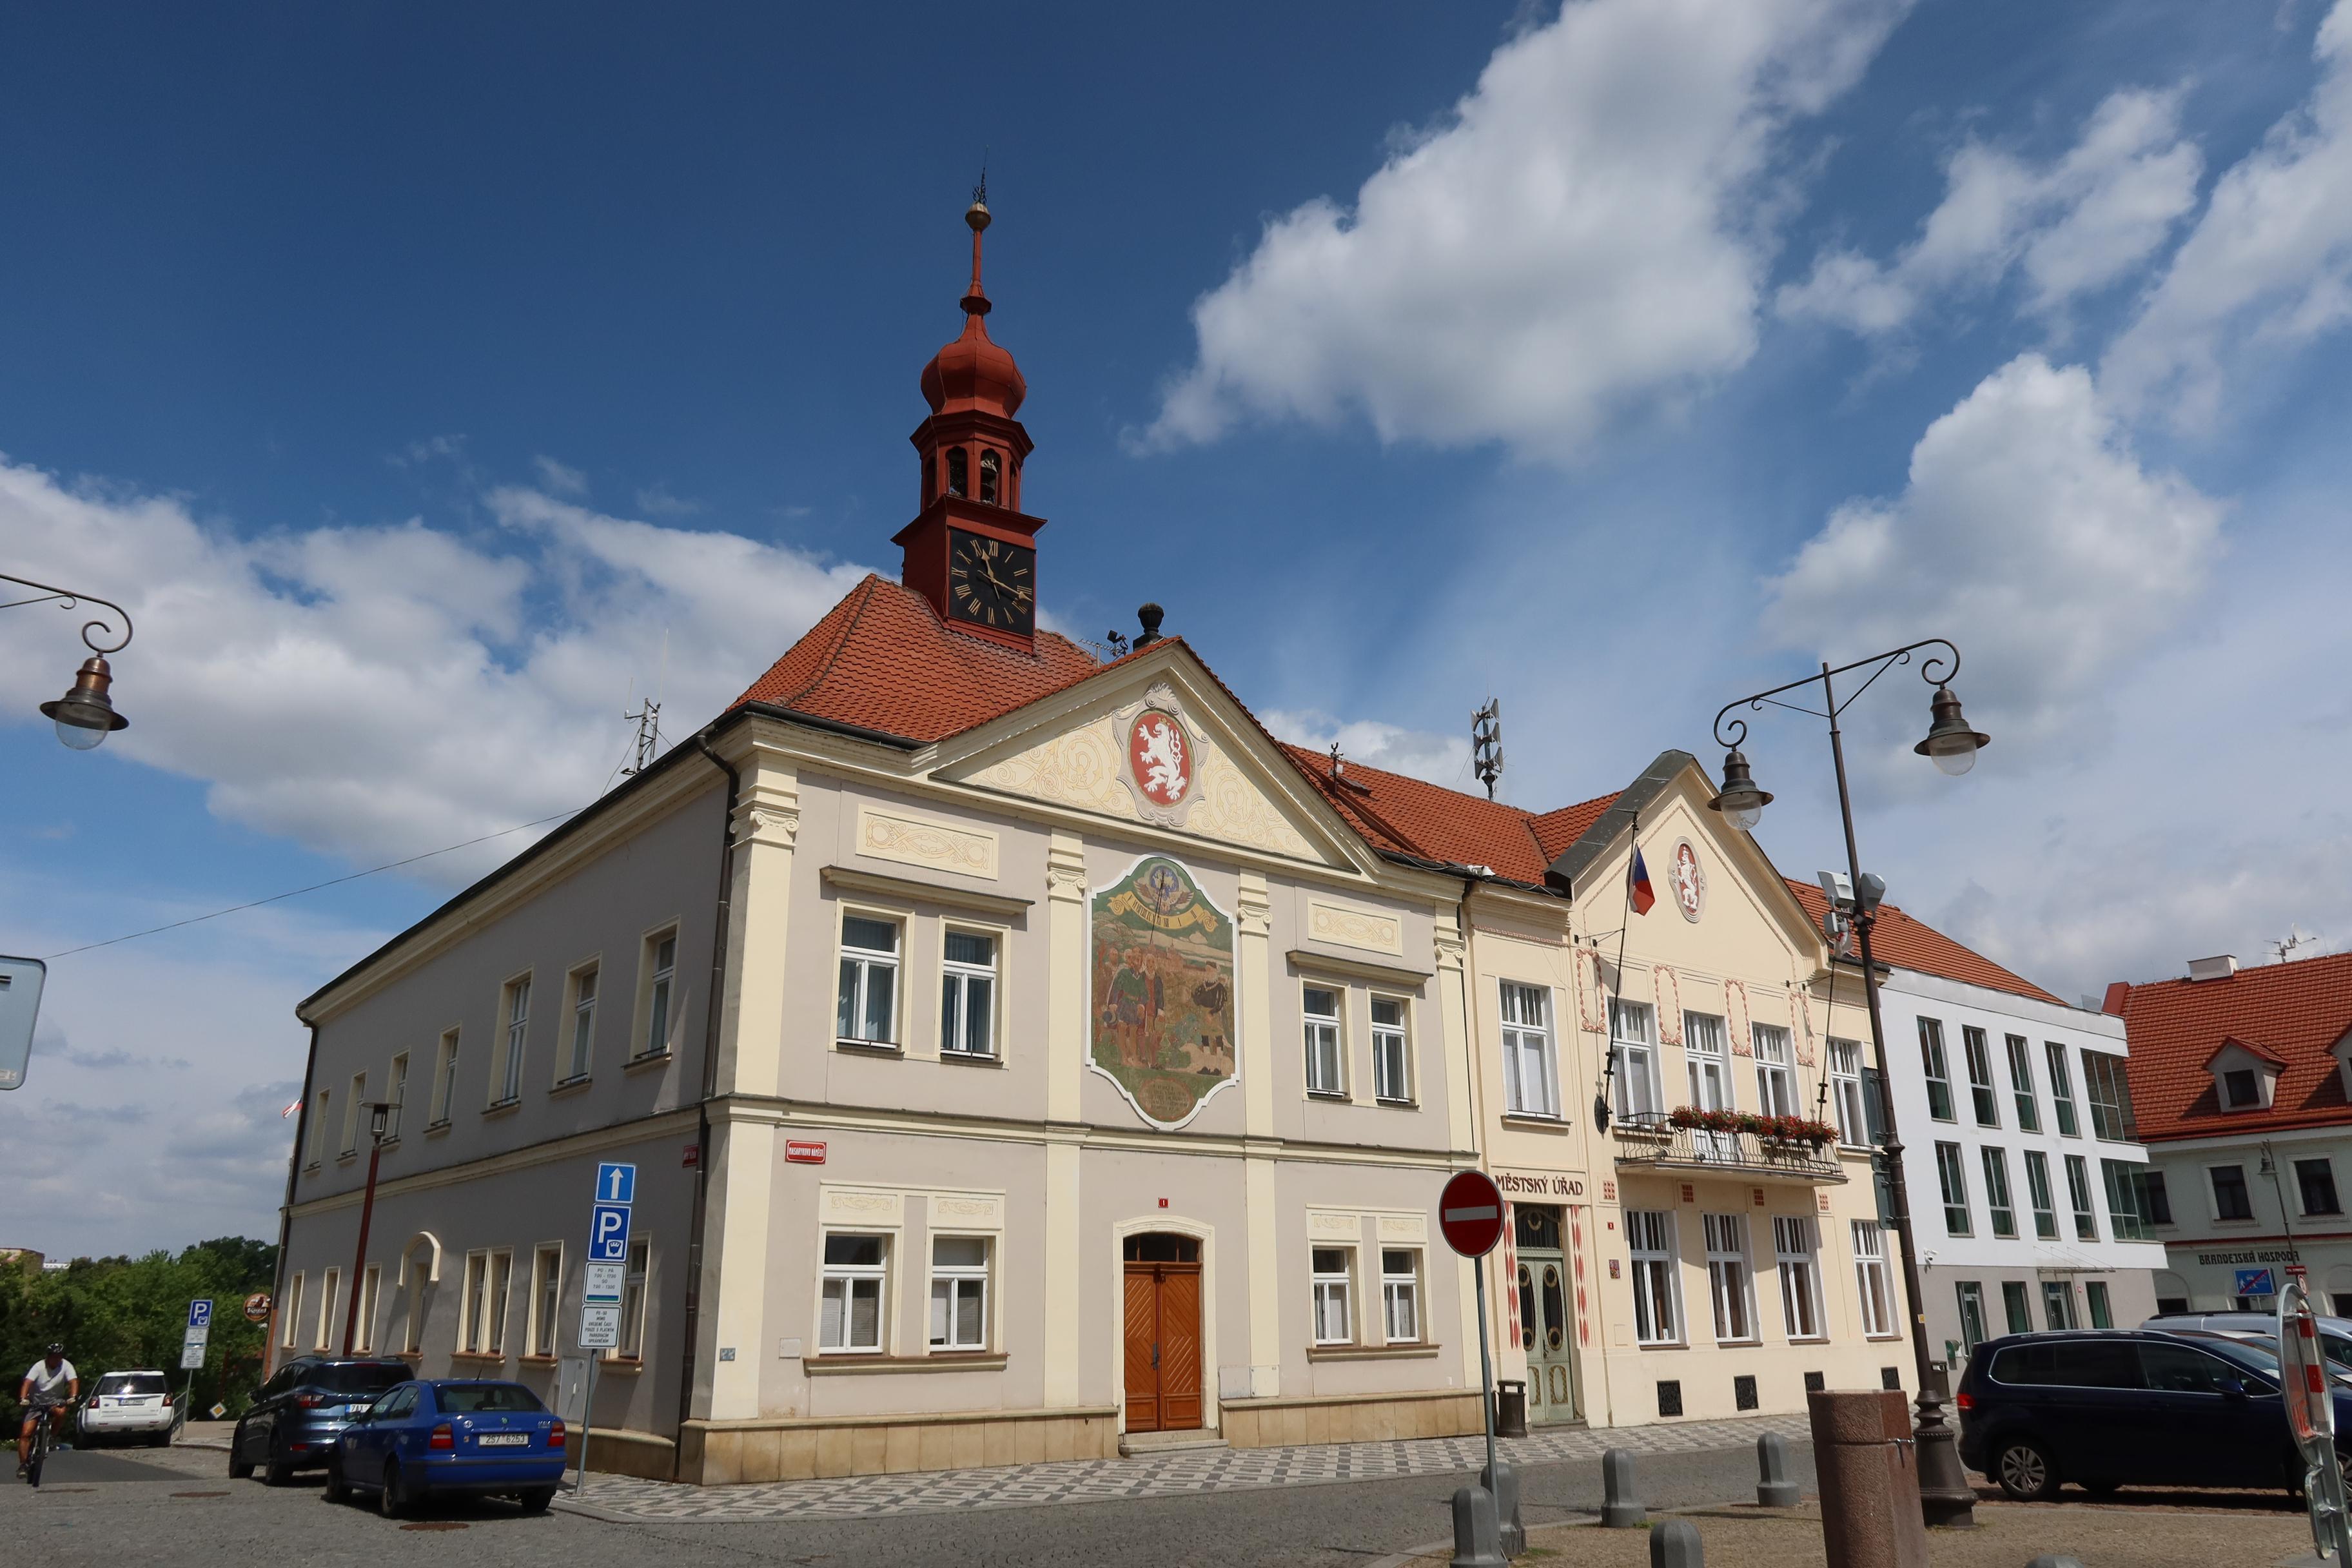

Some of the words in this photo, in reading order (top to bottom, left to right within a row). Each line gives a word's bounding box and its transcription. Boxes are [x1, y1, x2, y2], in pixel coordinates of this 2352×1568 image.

[989, 540, 998, 557] XII
[952, 567, 967, 578] IX
[955, 584, 972, 599] VIII
[968, 598, 981, 616] VII
[988, 607, 995, 624] VI
[789, 1147, 811, 1156] MASARYKOVO
[1494, 1172, 1549, 1195] MĚSTSKÝ
[1552, 1175, 1584, 1196] ÚŘAD
[598, 1211, 622, 1244] P
[2198, 1250, 2257, 1265] BRANDEJSKÁ
[2257, 1250, 2300, 1263] HOSPODA
[193, 1303, 208, 1319] P
[485, 1435, 501, 1444] 2S7
[505, 1434, 525, 1443] 6253
